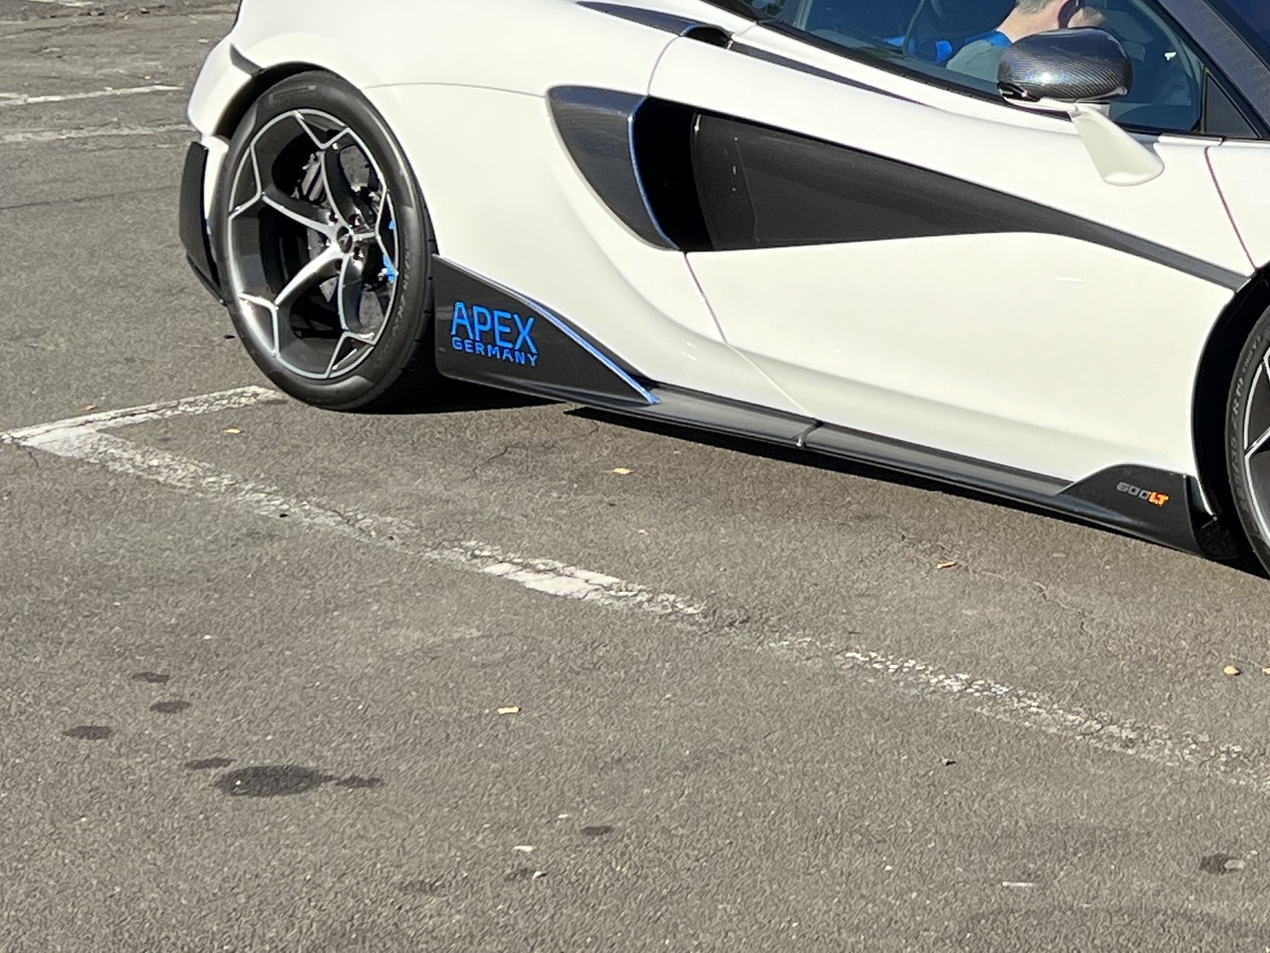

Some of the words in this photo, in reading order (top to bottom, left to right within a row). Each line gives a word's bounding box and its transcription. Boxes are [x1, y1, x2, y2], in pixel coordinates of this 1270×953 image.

[450, 301, 538, 354] APEX
[451, 336, 538, 367] GERMANY
[1116, 481, 1170, 507] 600LT
